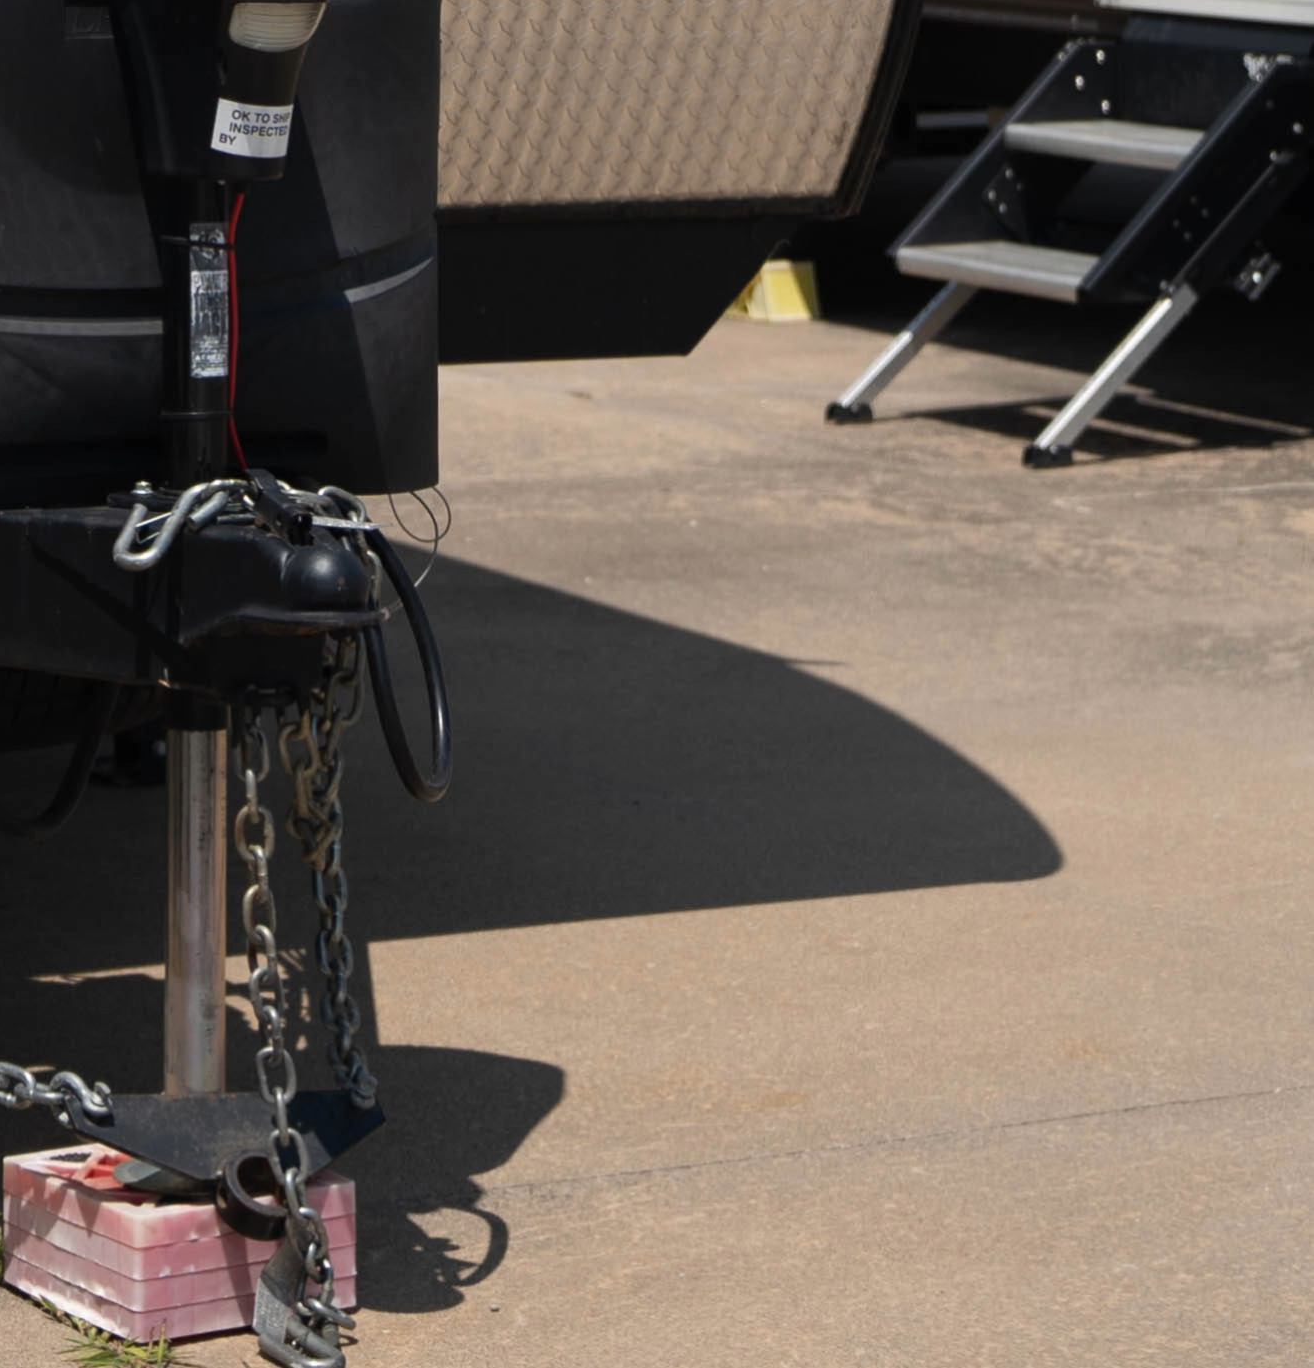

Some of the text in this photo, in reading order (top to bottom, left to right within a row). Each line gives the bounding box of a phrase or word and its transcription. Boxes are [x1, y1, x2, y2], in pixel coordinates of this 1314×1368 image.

[232, 109, 250, 122] OK
[254, 112, 270, 124] TO
[219, 133, 236, 145] BY
